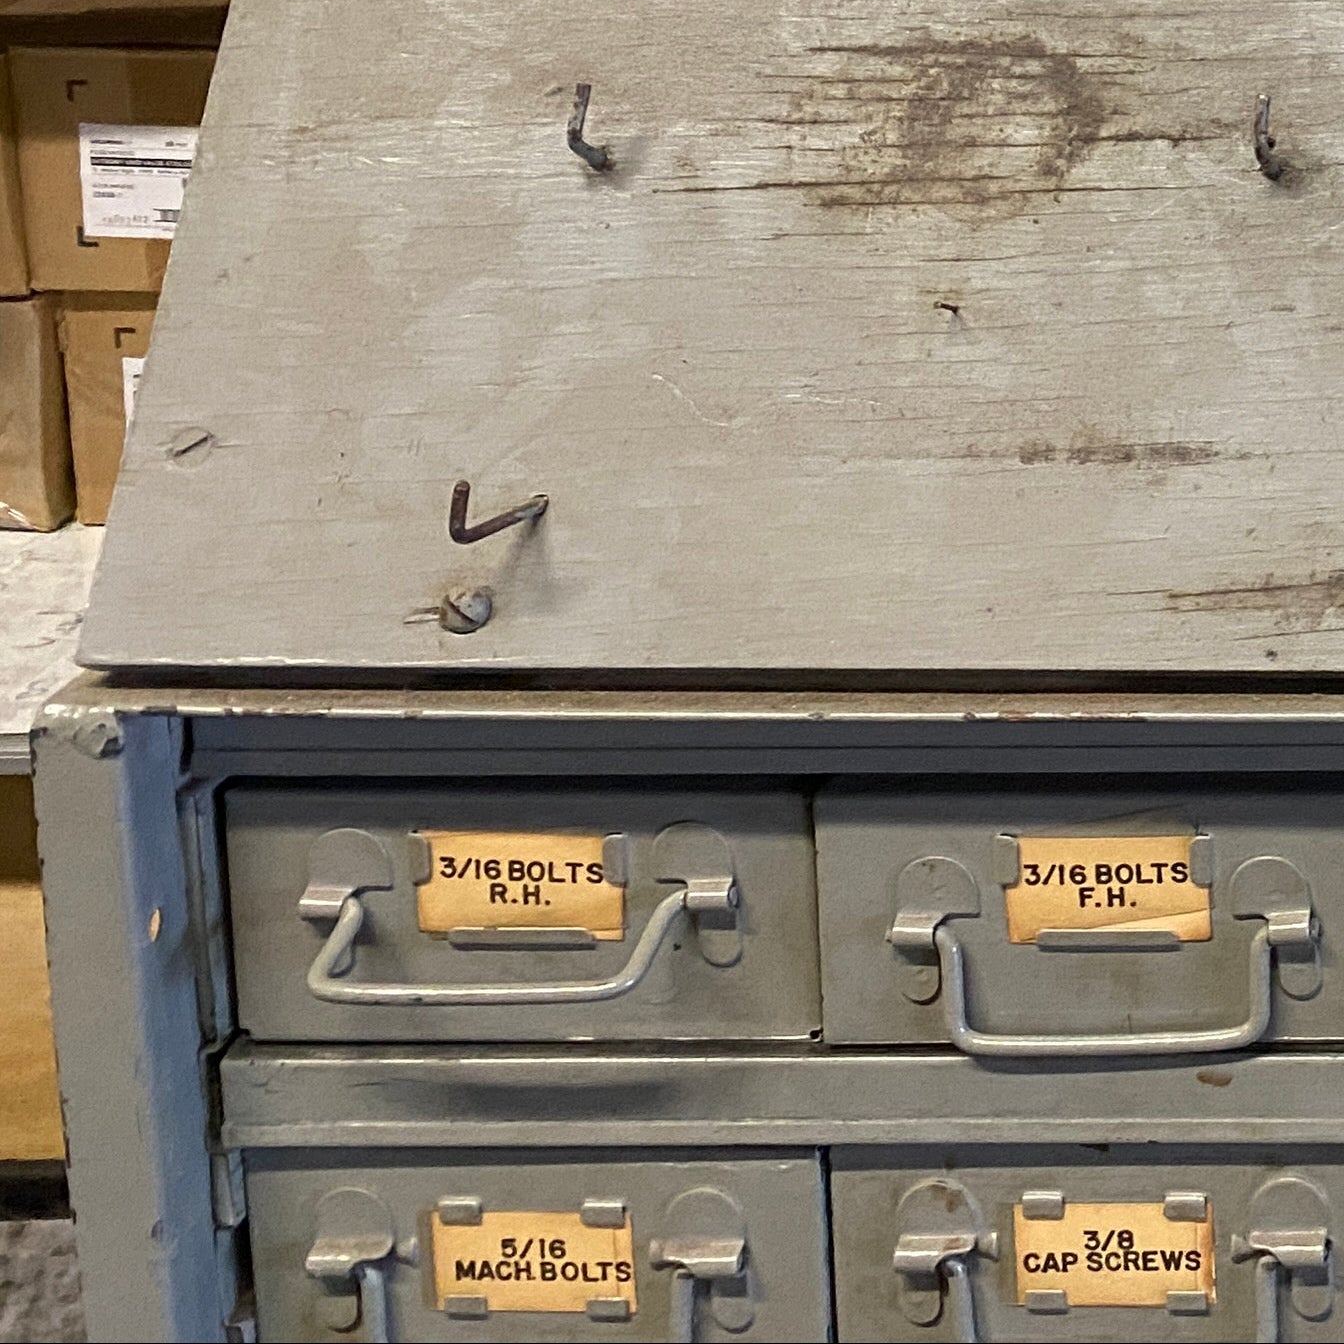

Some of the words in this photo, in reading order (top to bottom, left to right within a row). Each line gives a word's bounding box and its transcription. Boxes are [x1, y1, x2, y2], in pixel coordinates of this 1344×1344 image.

[439, 856, 501, 879] 3/16
[508, 860, 604, 884] BOLTS
[1023, 863, 1087, 886] 3/16
[1095, 862, 1189, 885] BOLTS
[489, 883, 552, 906] R.H.
[1079, 887, 1137, 908] F.H.
[501, 1238, 567, 1260] 5/16
[1083, 1230, 1134, 1251] 3/8
[1023, 1252, 1078, 1273] CAP
[1086, 1250, 1202, 1272] SCREWS
